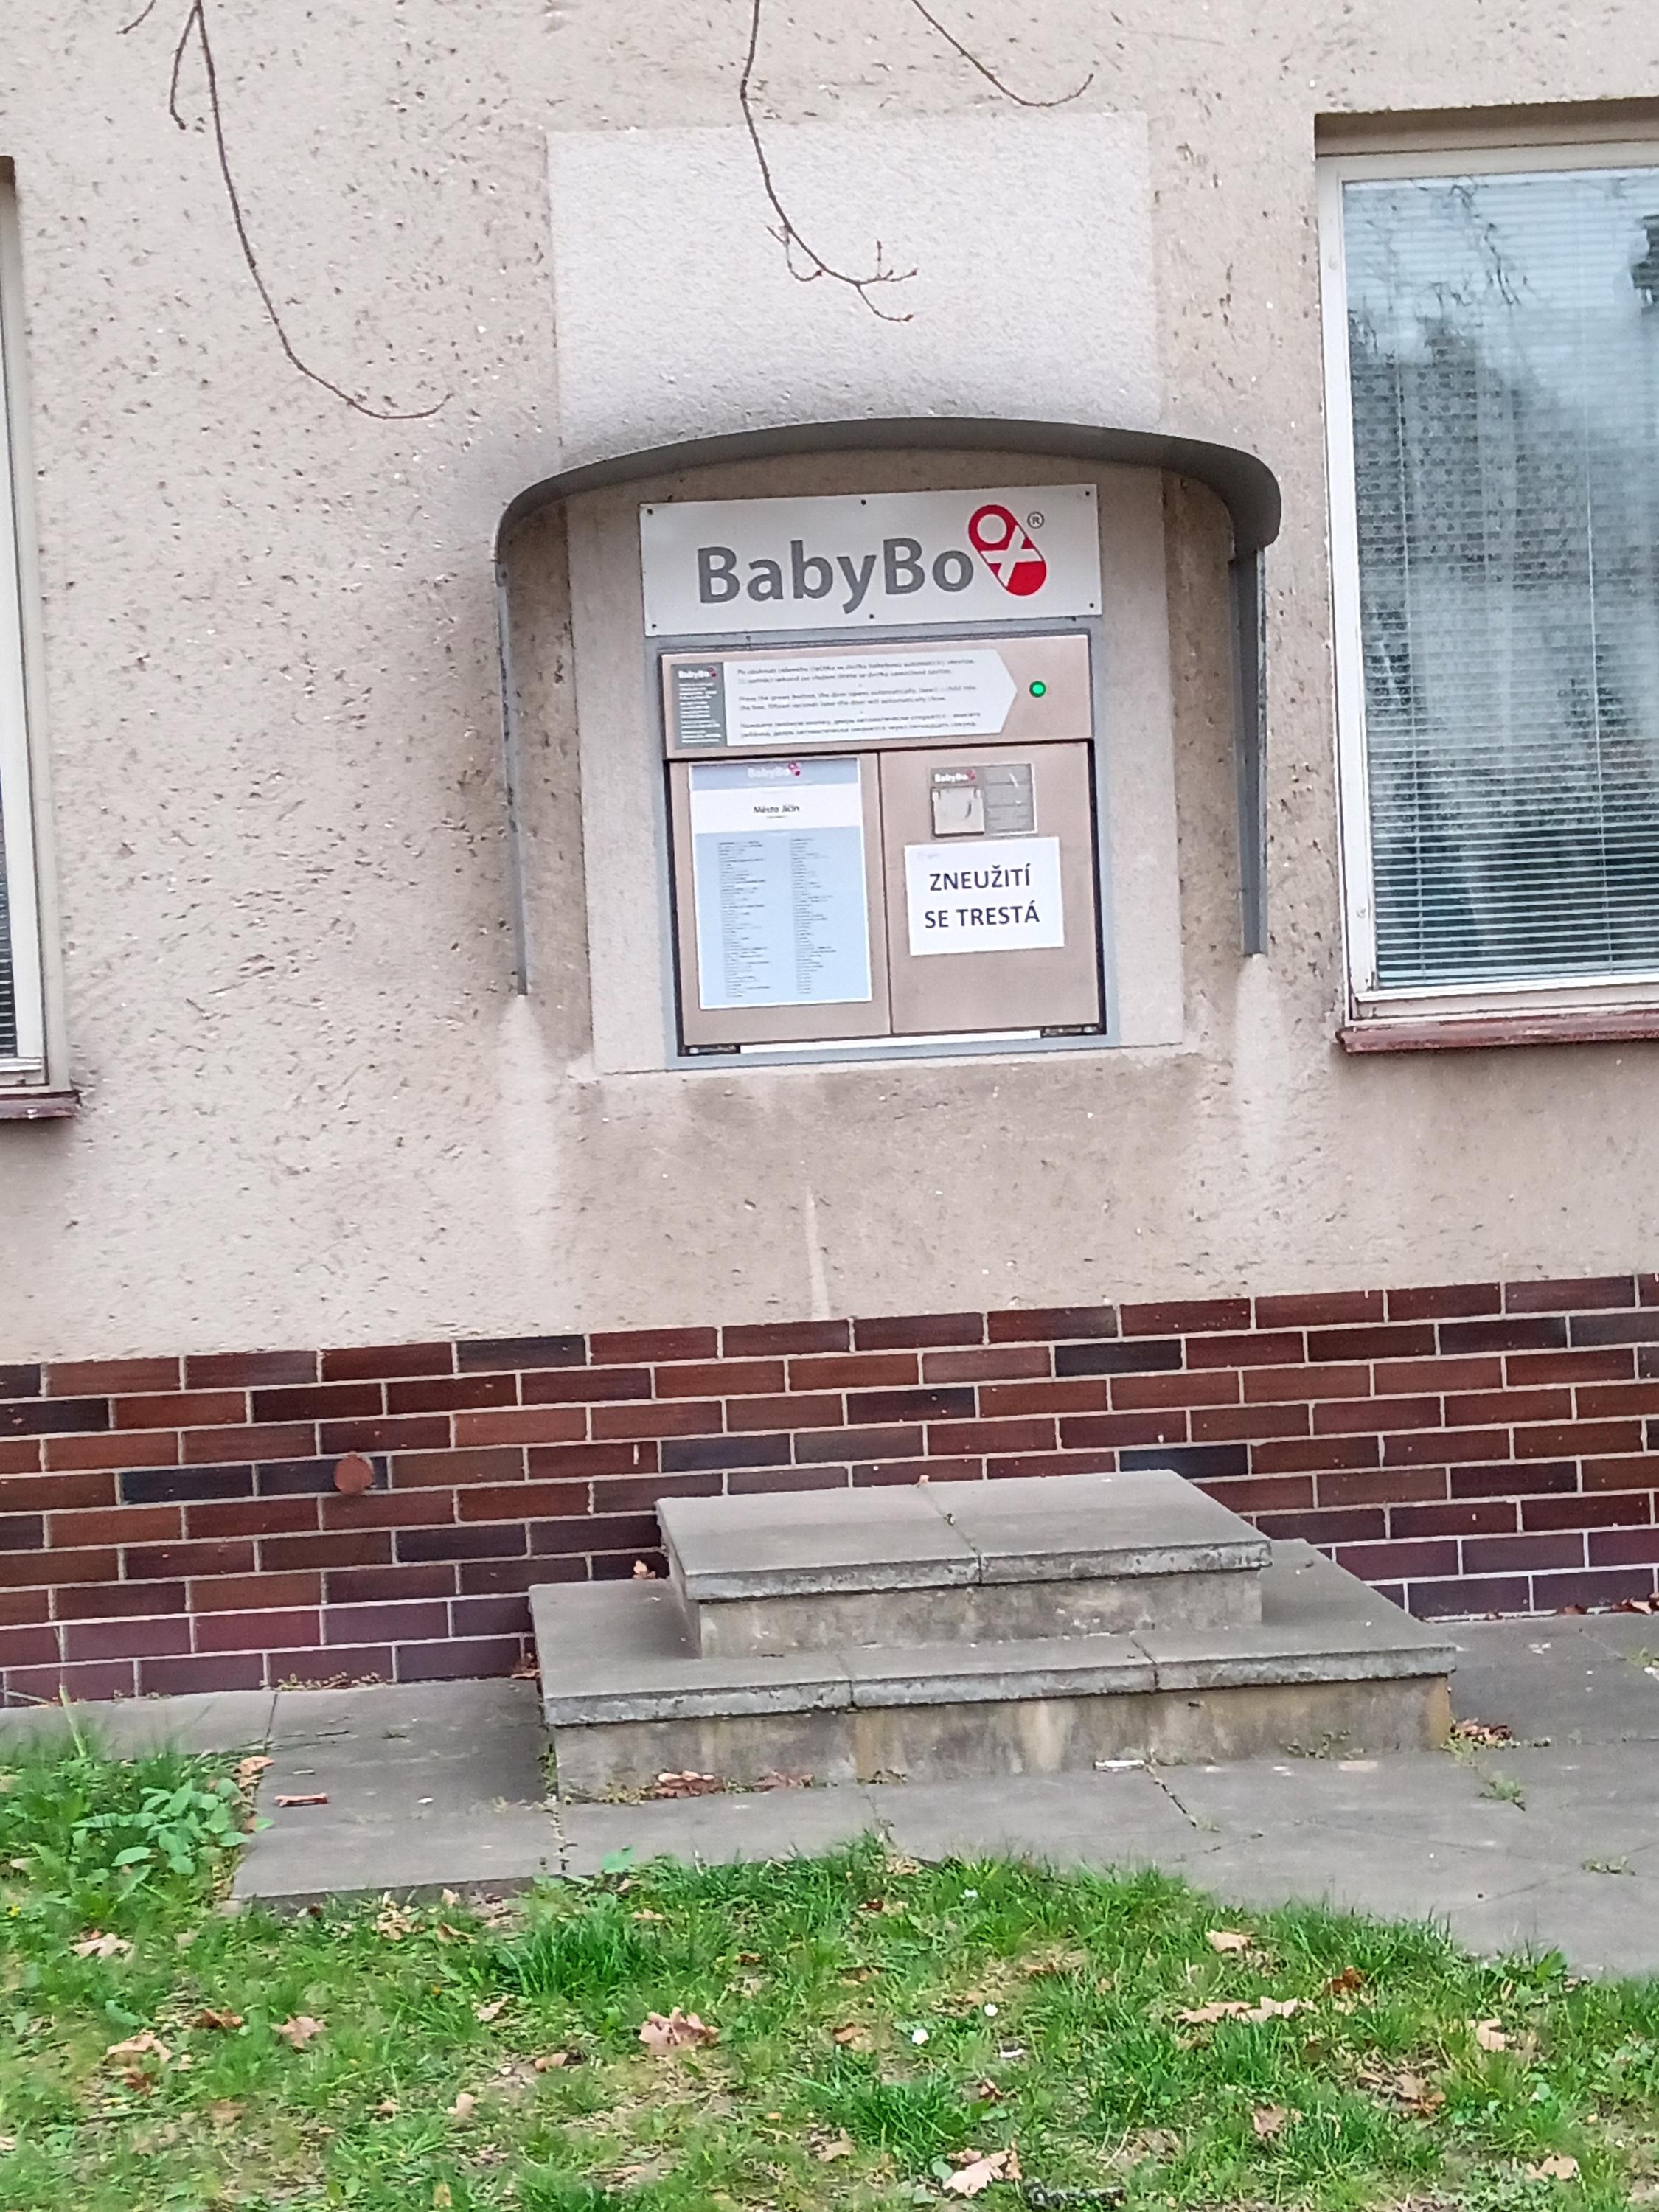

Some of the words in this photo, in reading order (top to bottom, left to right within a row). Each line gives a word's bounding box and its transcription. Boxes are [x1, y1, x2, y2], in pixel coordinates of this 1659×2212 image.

[929, 863, 1032, 891] ZNEUŽITÍ
[925, 909, 949, 929] SE
[956, 900, 1040, 927] TRESTÁ
